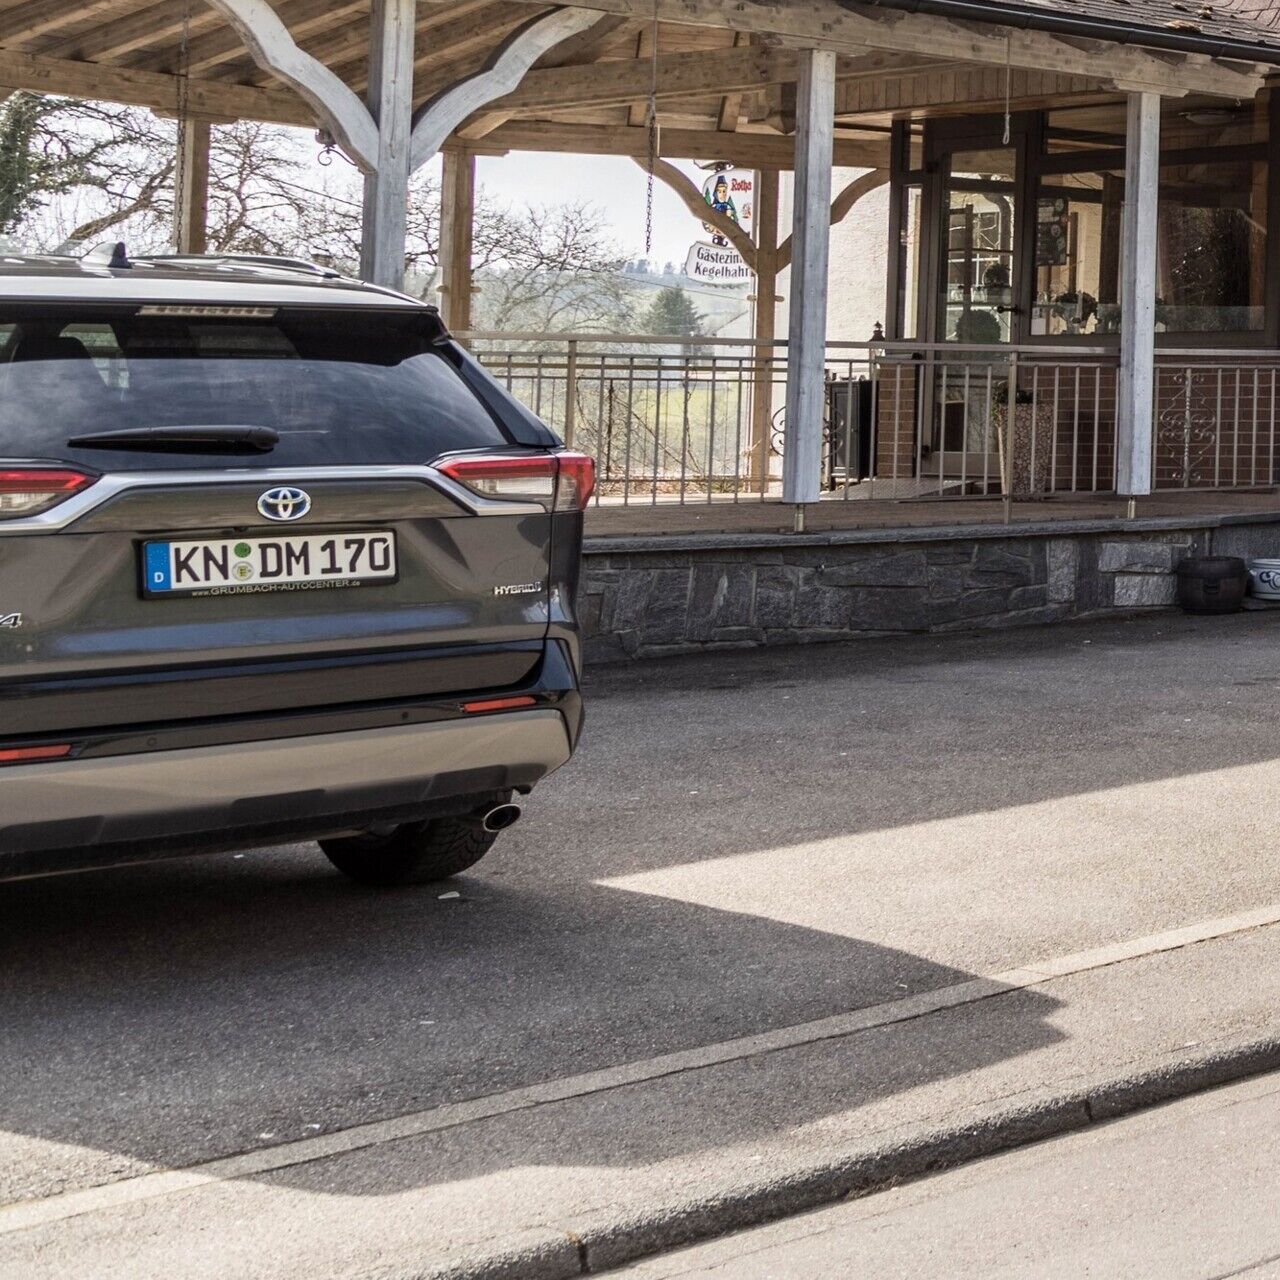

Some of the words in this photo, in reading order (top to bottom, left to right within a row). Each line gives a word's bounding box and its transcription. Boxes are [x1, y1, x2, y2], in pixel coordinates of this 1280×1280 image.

[173, 544, 229, 583] KN
[258, 540, 310, 578] DM
[320, 537, 391, 574] 170
[153, 571, 165, 583] D
[191, 580, 361, 597] www.GRUMBACH-AUTOCENTER.de
